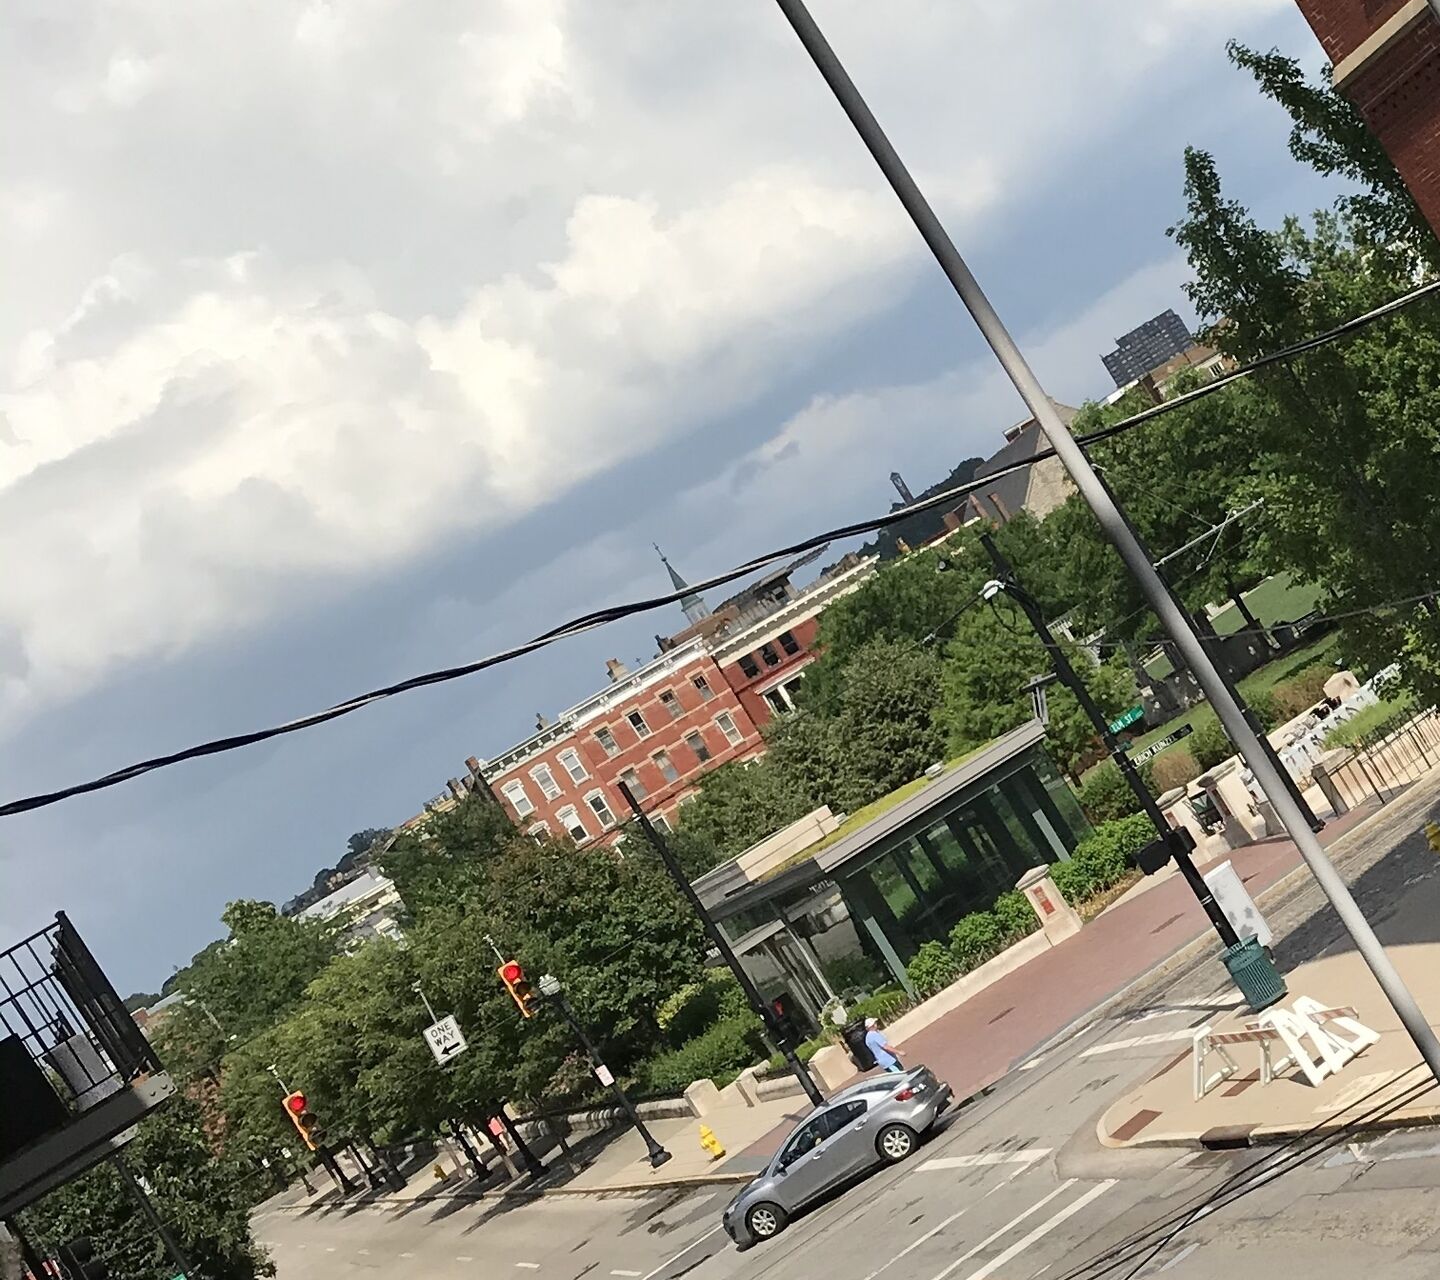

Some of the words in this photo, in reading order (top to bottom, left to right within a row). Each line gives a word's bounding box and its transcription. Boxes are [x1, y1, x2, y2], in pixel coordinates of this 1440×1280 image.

[1124, 713, 1134, 727] ST
[1151, 734, 1178, 755] KUNZEL
[430, 1021, 451, 1038] ONE
[434, 1029, 455, 1047] WAY
